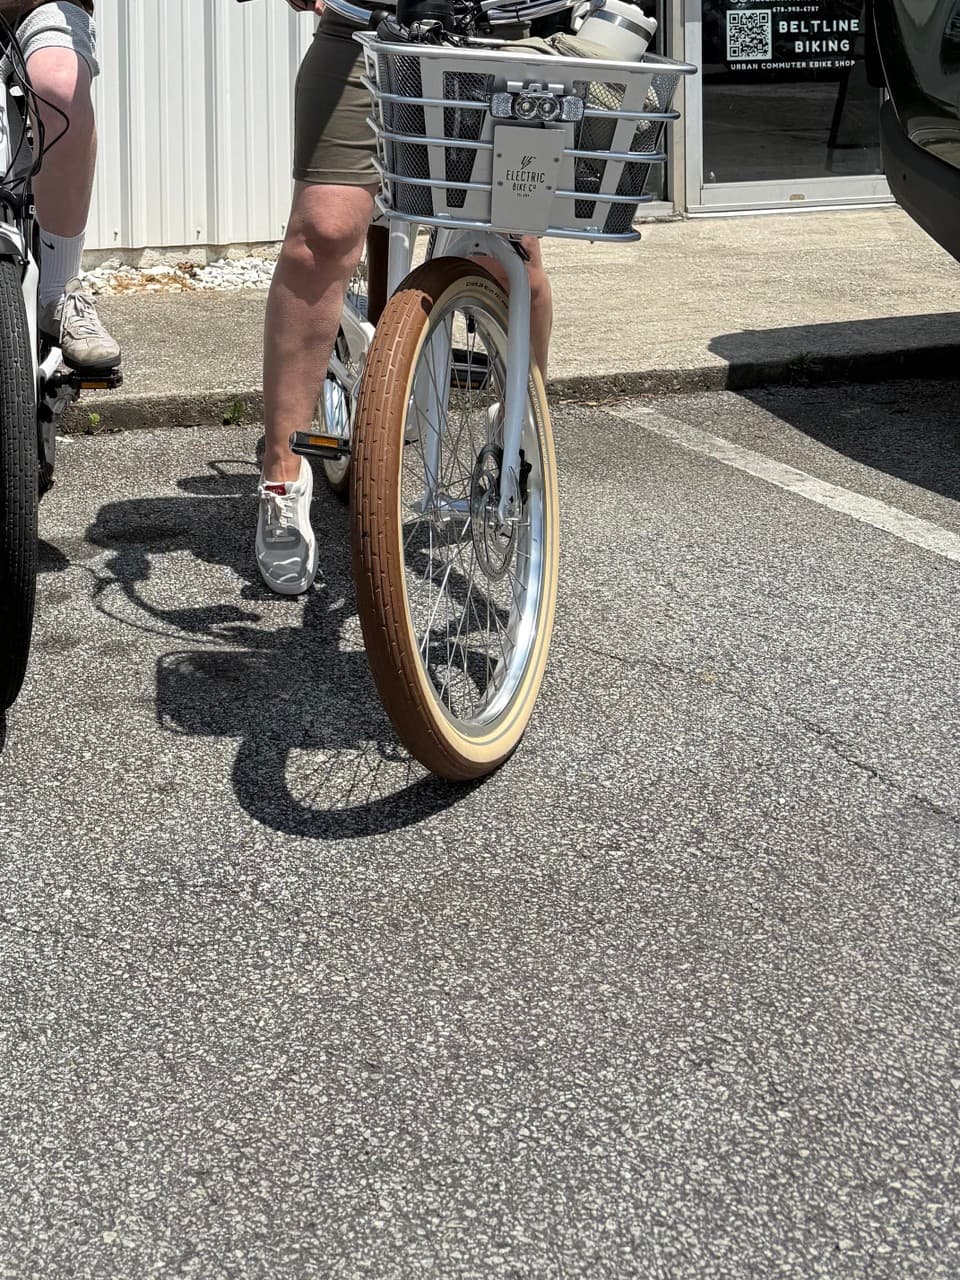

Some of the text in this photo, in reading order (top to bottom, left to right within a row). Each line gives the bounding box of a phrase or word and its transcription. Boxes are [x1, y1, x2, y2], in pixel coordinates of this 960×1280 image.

[778, 19, 860, 34] BELTLINE
[794, 39, 851, 54] BIKING
[730, 59, 856, 70] URBAN COMMUTER EBIKE SHOP
[506, 170, 546, 183] ELECTRIC
[512, 183, 526, 192] BIKE
